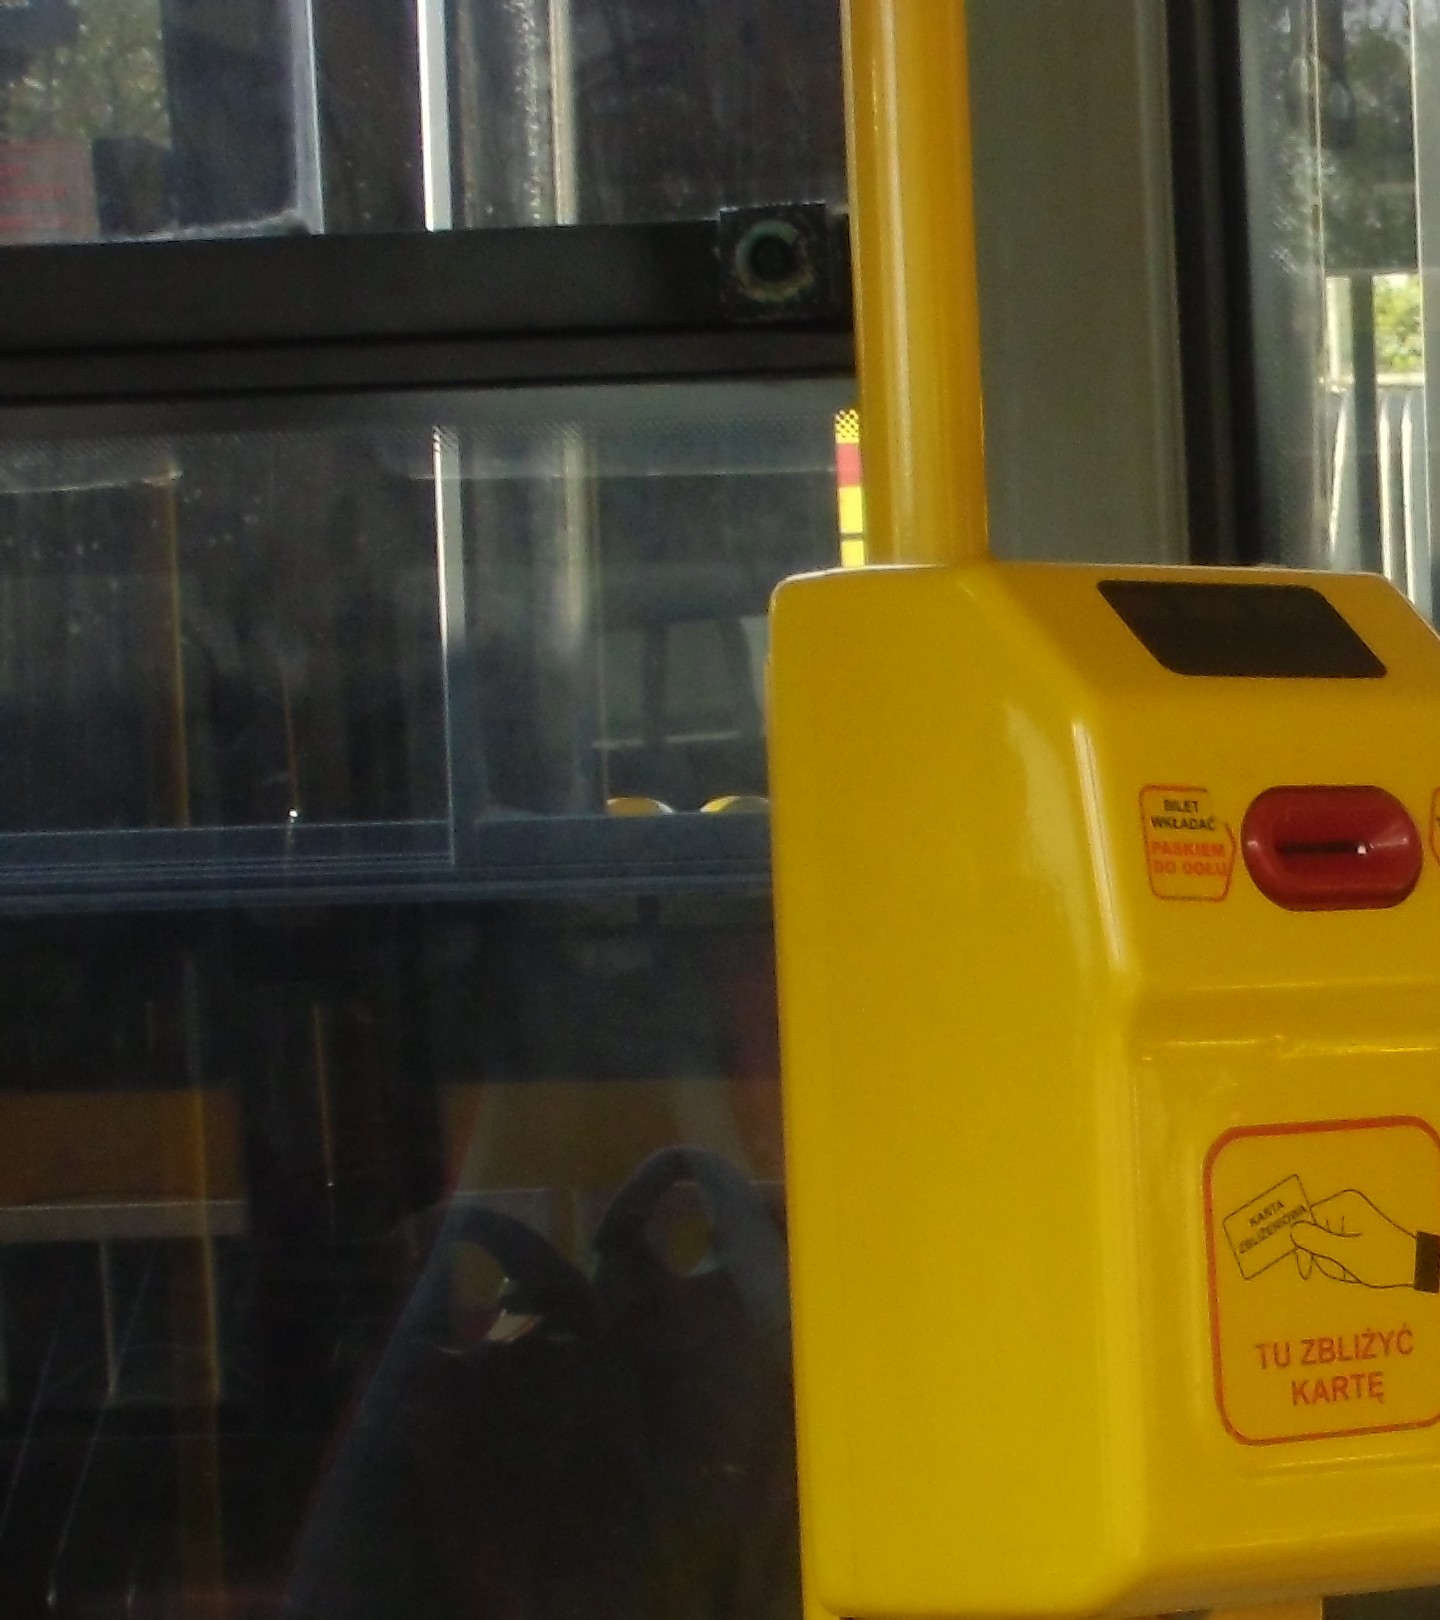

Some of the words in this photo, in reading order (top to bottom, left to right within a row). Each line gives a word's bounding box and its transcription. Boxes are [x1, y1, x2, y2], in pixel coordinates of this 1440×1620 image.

[1254, 1341, 1292, 1370] TU
[1300, 1322, 1415, 1367] ZBLIŻYĆ
[1290, 1370, 1386, 1406] KARTĘ
